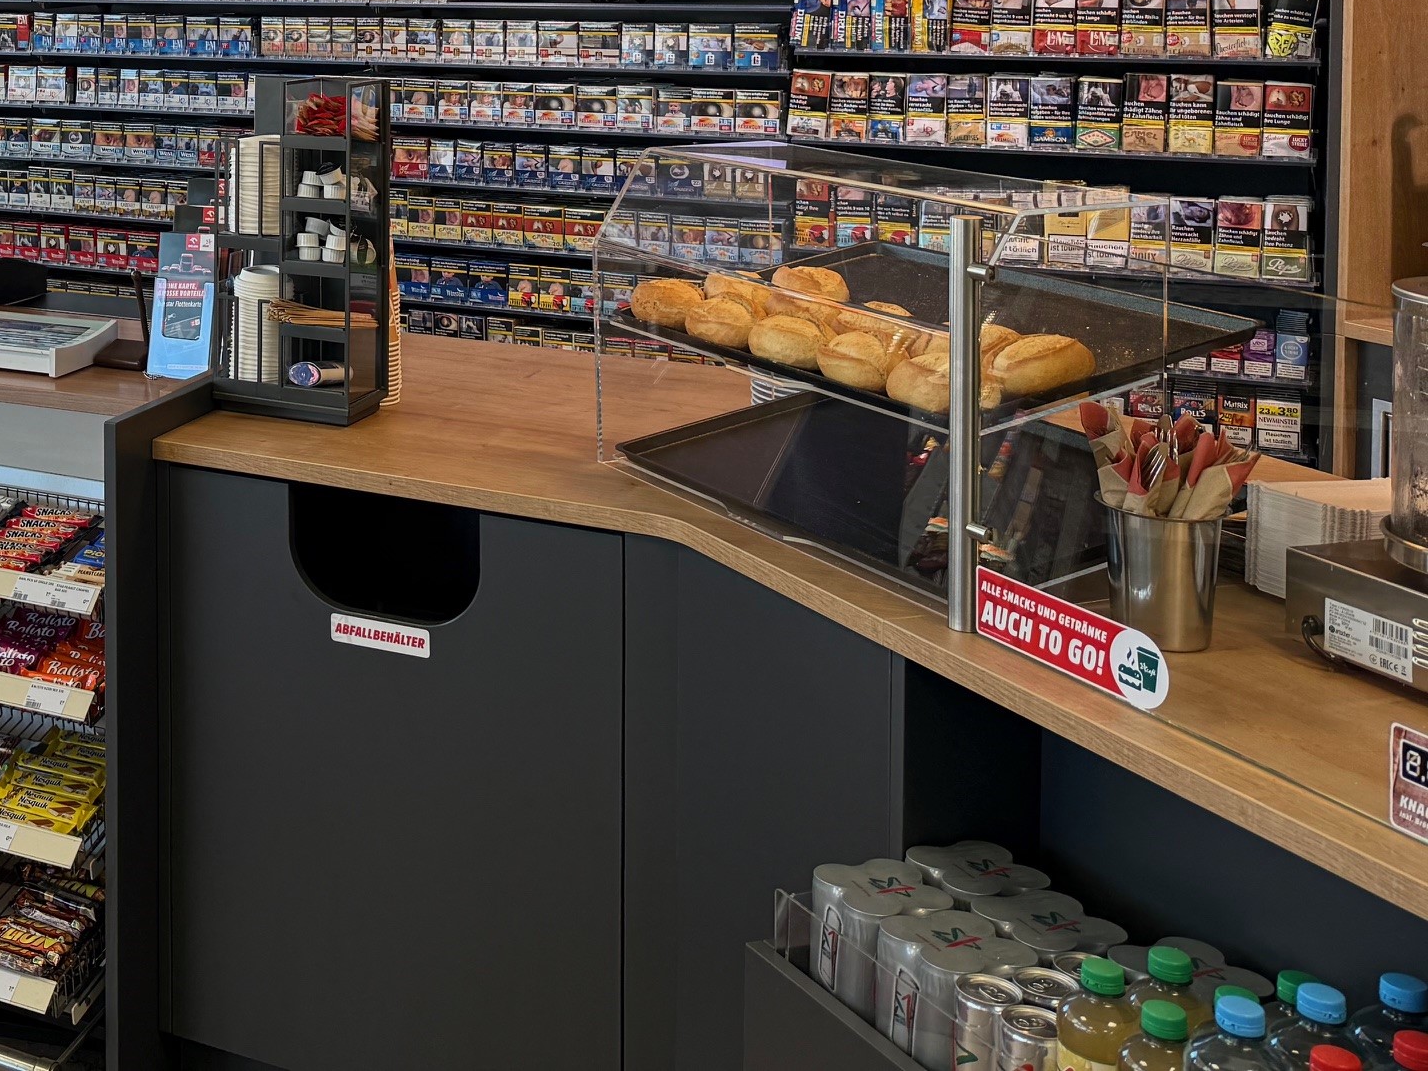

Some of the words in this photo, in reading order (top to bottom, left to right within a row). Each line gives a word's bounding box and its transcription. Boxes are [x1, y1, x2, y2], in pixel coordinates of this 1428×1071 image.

[792, 8, 805, 44] DRUM
[837, 10, 845, 42] DRUM
[1033, 135, 1067, 143] SAMSON
[1258, 417, 1298, 426] NEWMINSTER
[36, 508, 72, 516] SNACKS
[981, 581, 1001, 598] ALLE
[1003, 590, 1036, 613] SNACKS
[1037, 605, 1056, 621] UND
[1058, 613, 1108, 643] GETRÄNKE
[26, 613, 76, 626] Balisto
[7, 621, 55, 637] Balisto
[335, 623, 425, 649] ABFALLBEHÄLTER
[981, 601, 1033, 643] AUCH
[1038, 624, 1062, 655] TO
[1068, 639, 1106, 675] GO!
[46, 660, 100, 678] Balisto
[41, 758, 69, 769] Nesquik
[34, 776, 61, 787] Nesquik
[19, 796, 48, 809] Nesquik
